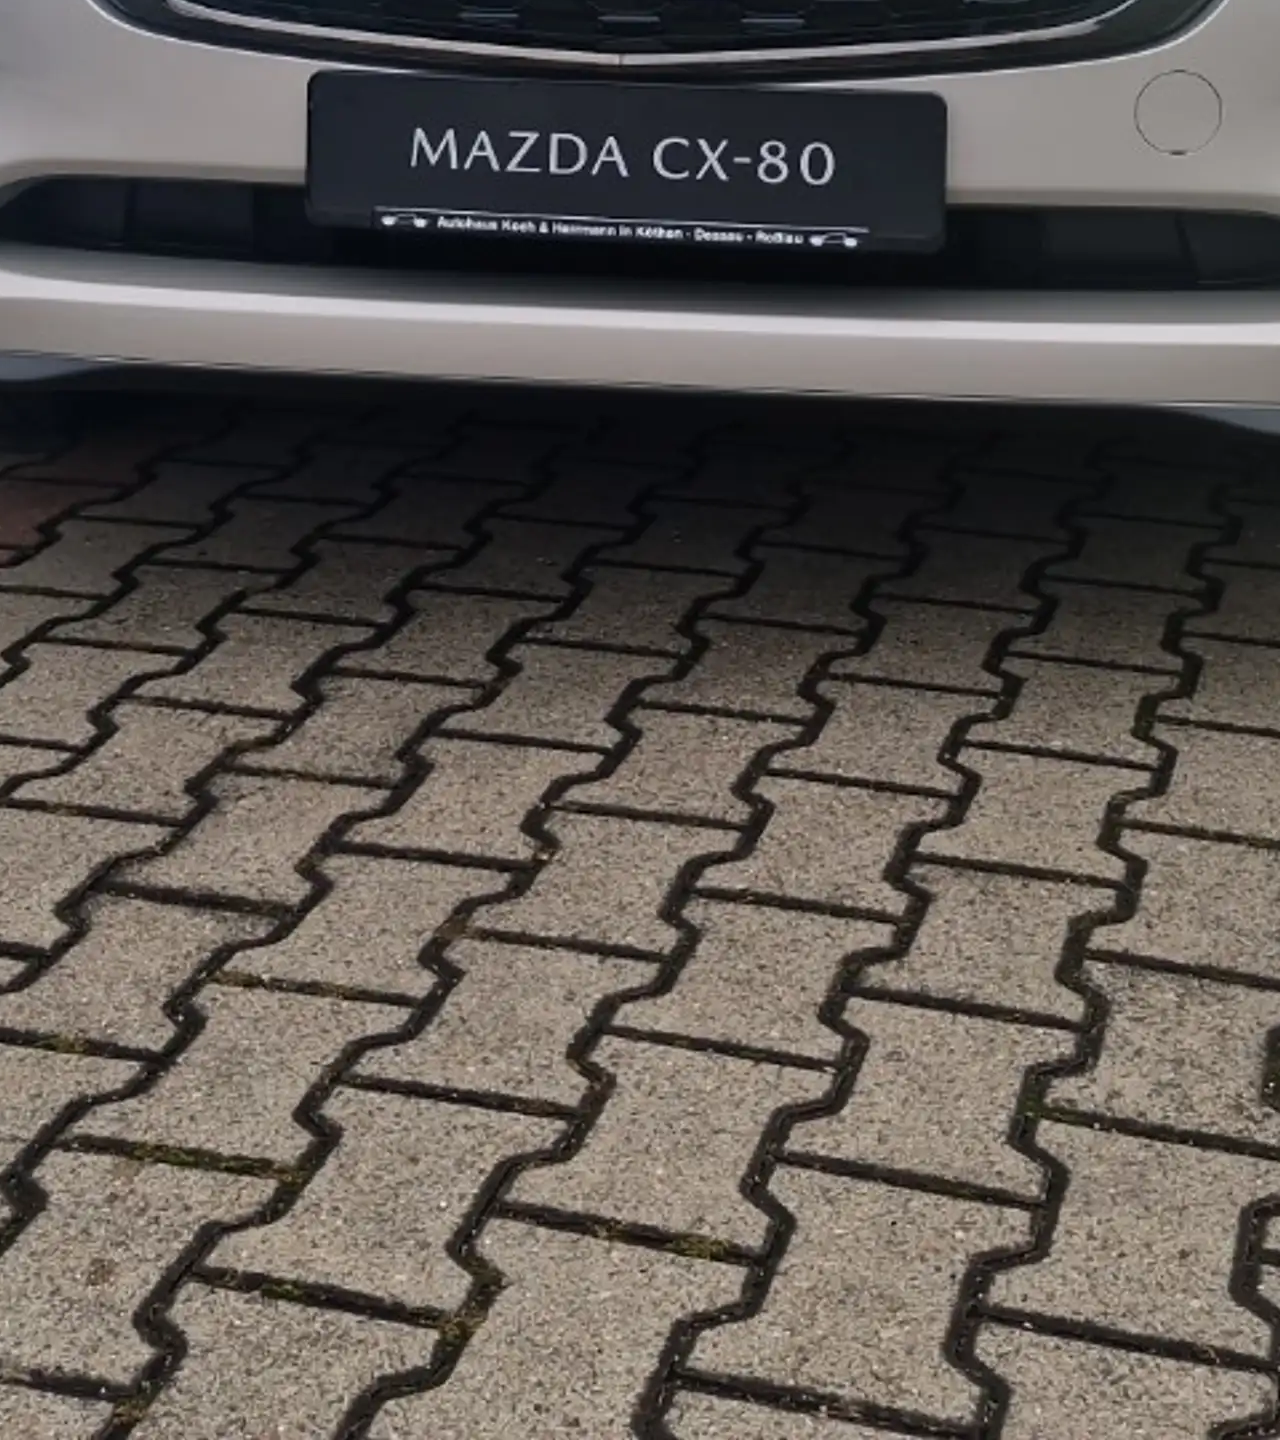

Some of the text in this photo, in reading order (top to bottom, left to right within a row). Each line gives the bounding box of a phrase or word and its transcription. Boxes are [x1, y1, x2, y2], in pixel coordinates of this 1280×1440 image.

[410, 127, 836, 186] MAZDA CX-80
[437, 216, 498, 231] Autohaus
[502, 219, 536, 233] Koch
[539, 222, 549, 234] &
